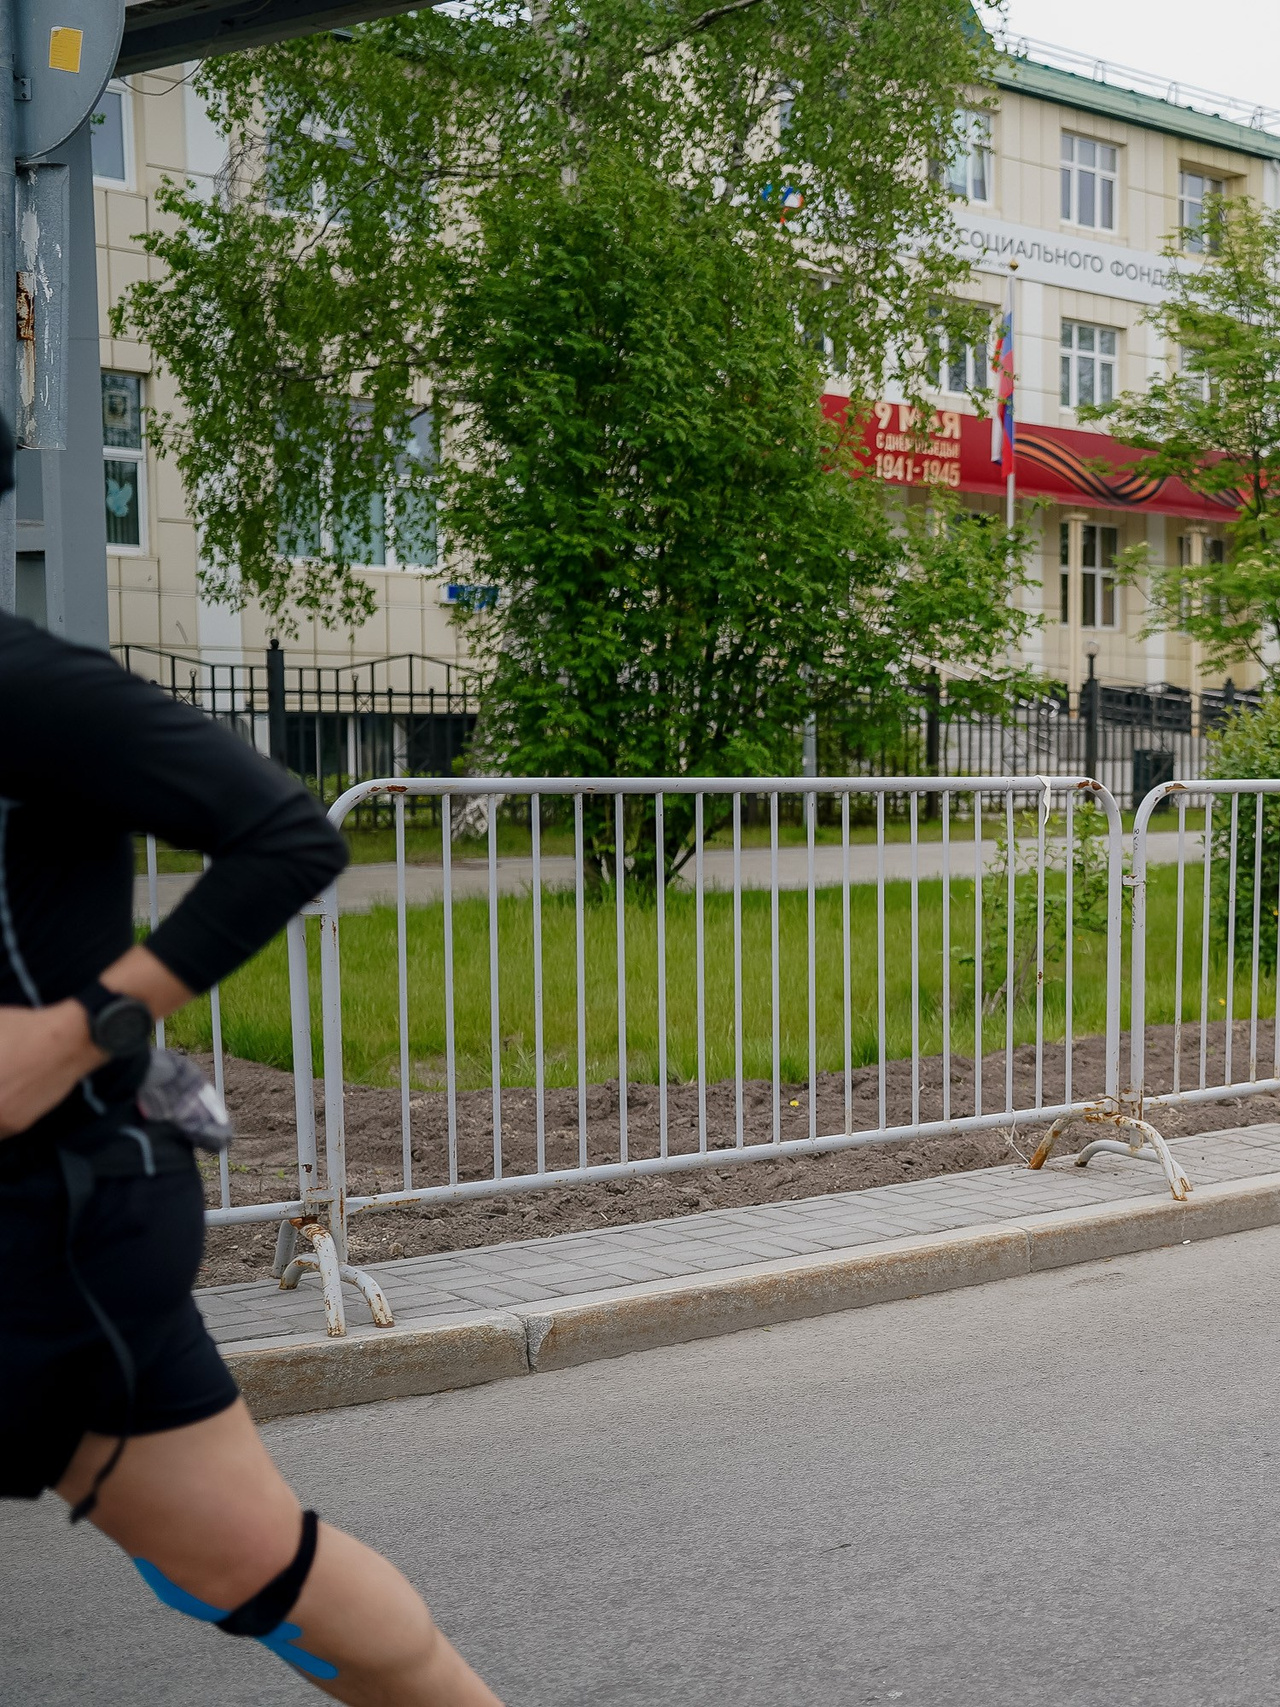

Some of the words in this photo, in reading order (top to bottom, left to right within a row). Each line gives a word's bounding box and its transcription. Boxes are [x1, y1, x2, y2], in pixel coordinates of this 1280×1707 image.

[957, 228, 1104, 274] СОЦИАЛЬНОГО
[874, 402, 893, 430] 9
[876, 432, 885, 449] С
[874, 453, 961, 488] 1941-1945
